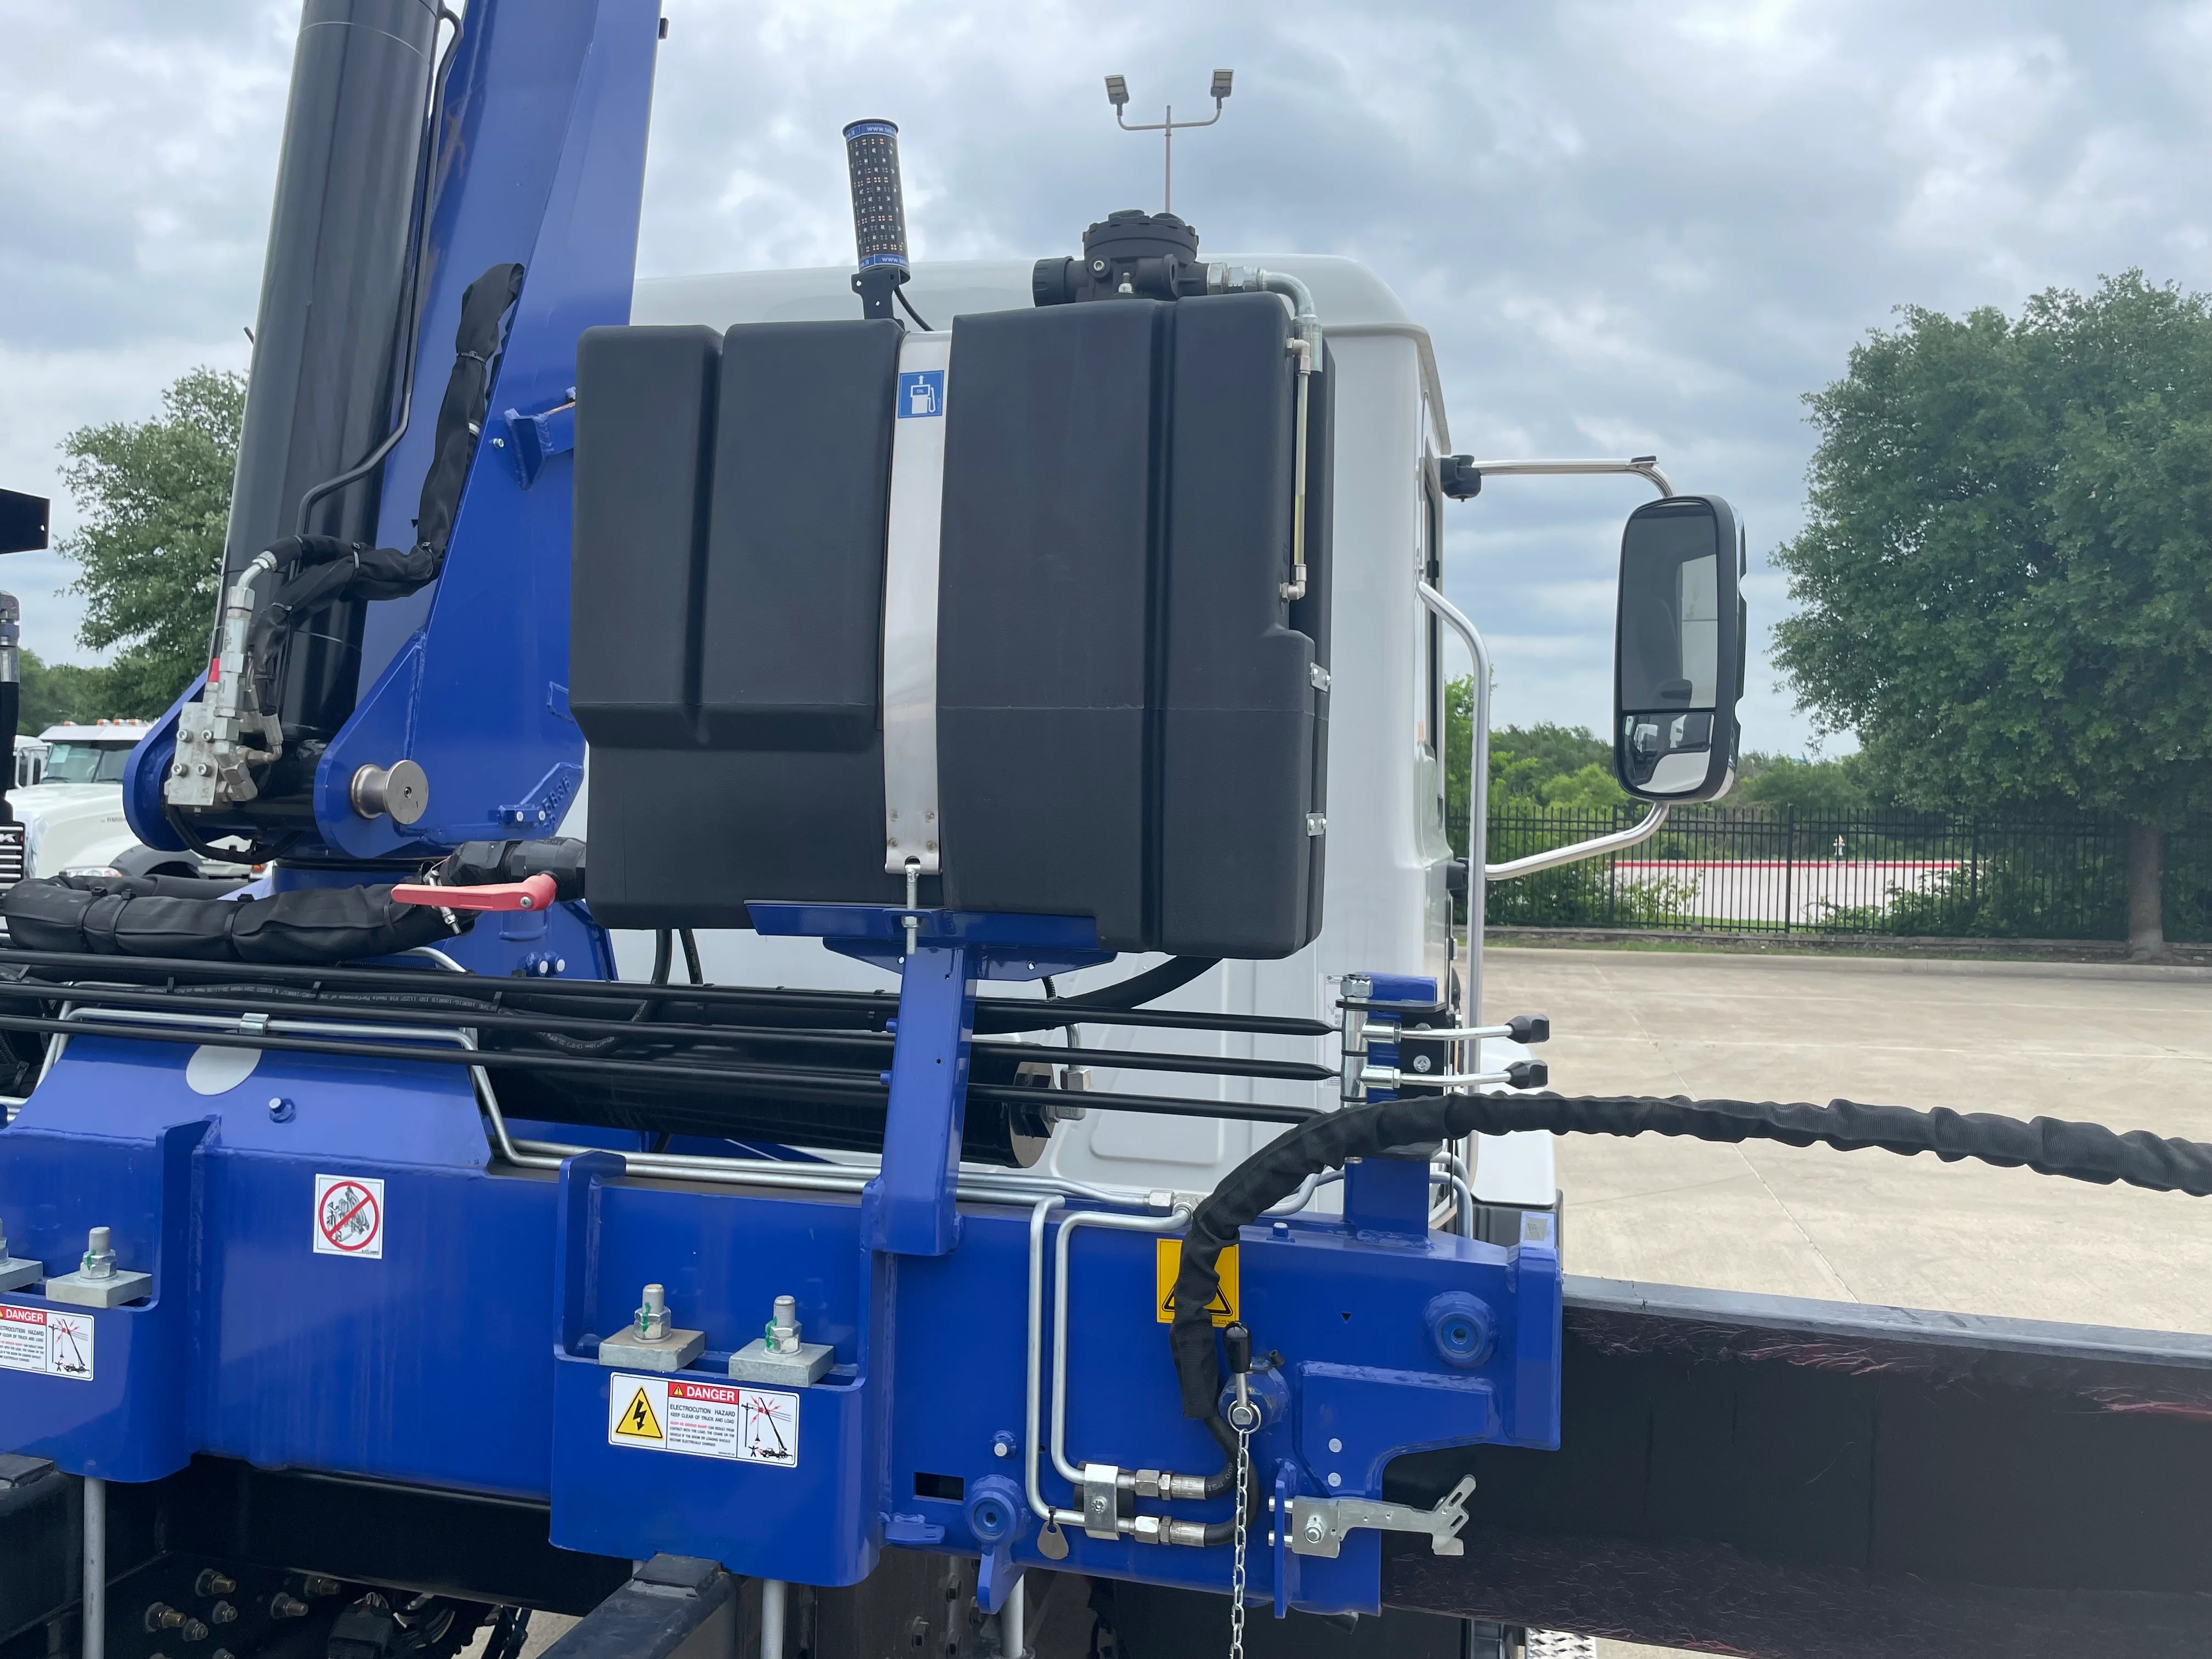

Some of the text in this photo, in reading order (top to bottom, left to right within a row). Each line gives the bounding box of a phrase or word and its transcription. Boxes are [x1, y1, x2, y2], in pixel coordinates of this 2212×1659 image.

[6, 1309, 43, 1323] DANGER
[686, 1386, 735, 1402] DANGER
[670, 1404, 711, 1414] ELECTROCUTION
[1207, 1481, 1223, 1491] PSI
